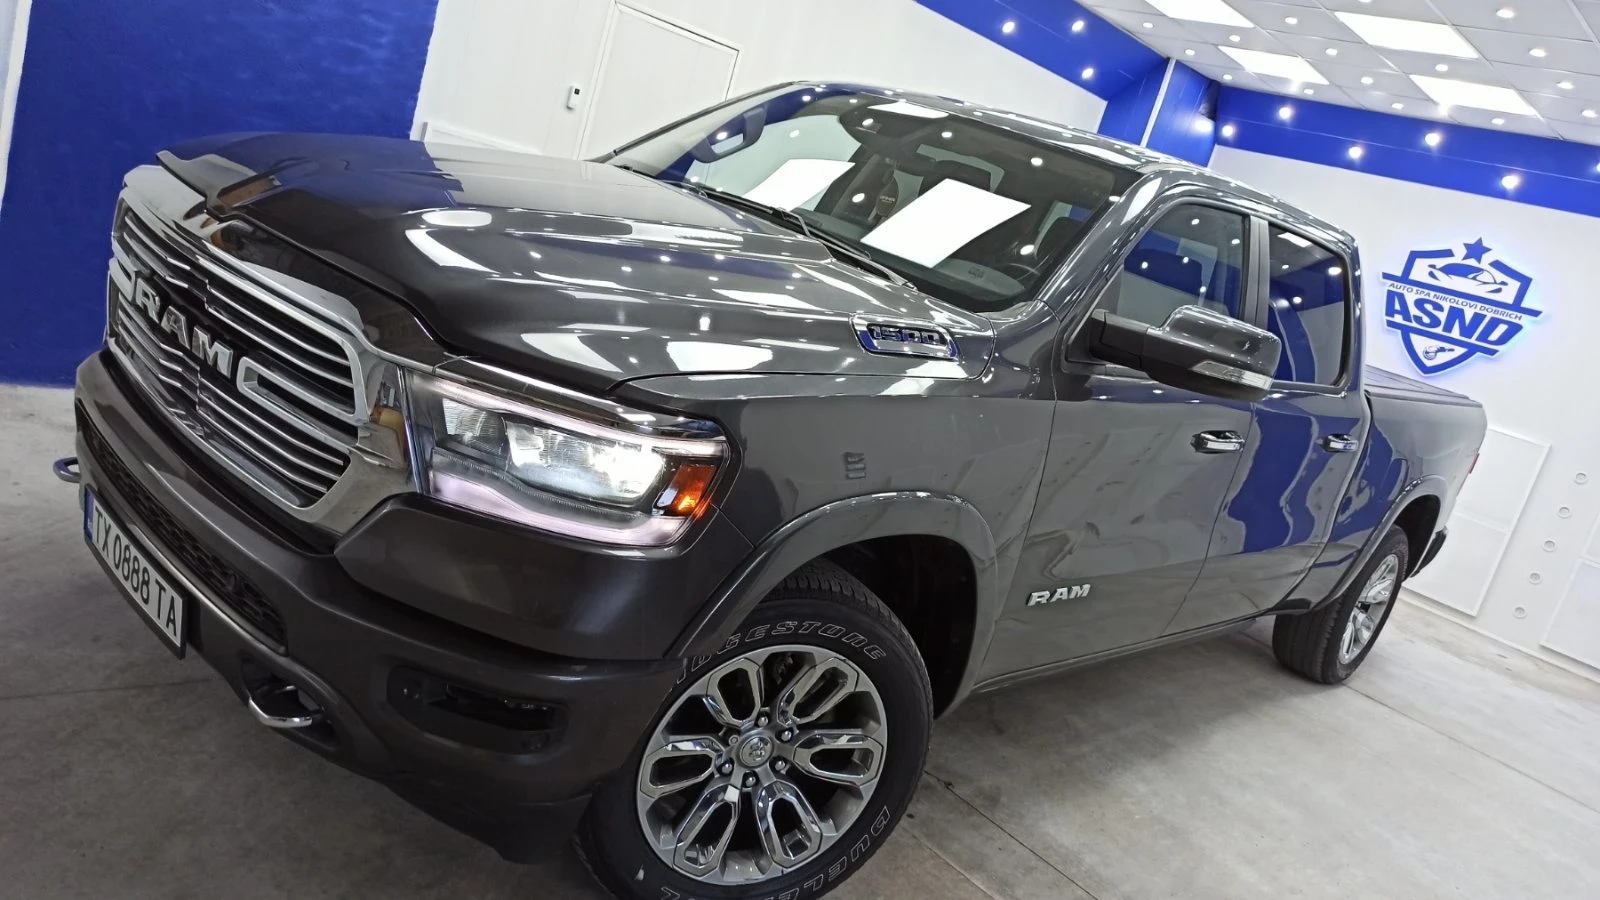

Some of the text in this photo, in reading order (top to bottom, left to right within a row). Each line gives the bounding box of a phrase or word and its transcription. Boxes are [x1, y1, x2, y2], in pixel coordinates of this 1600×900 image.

[135, 278, 234, 379] RAM
[1385, 289, 1524, 346] ASND
[1388, 282, 1523, 321] AUTO SPA NIKOLOVI DOBRICH
[869, 326, 941, 345] 1500
[95, 505, 177, 637] TX 0888 TA
[1027, 583, 1091, 607] RAM
[764, 805, 891, 900] DUELE
